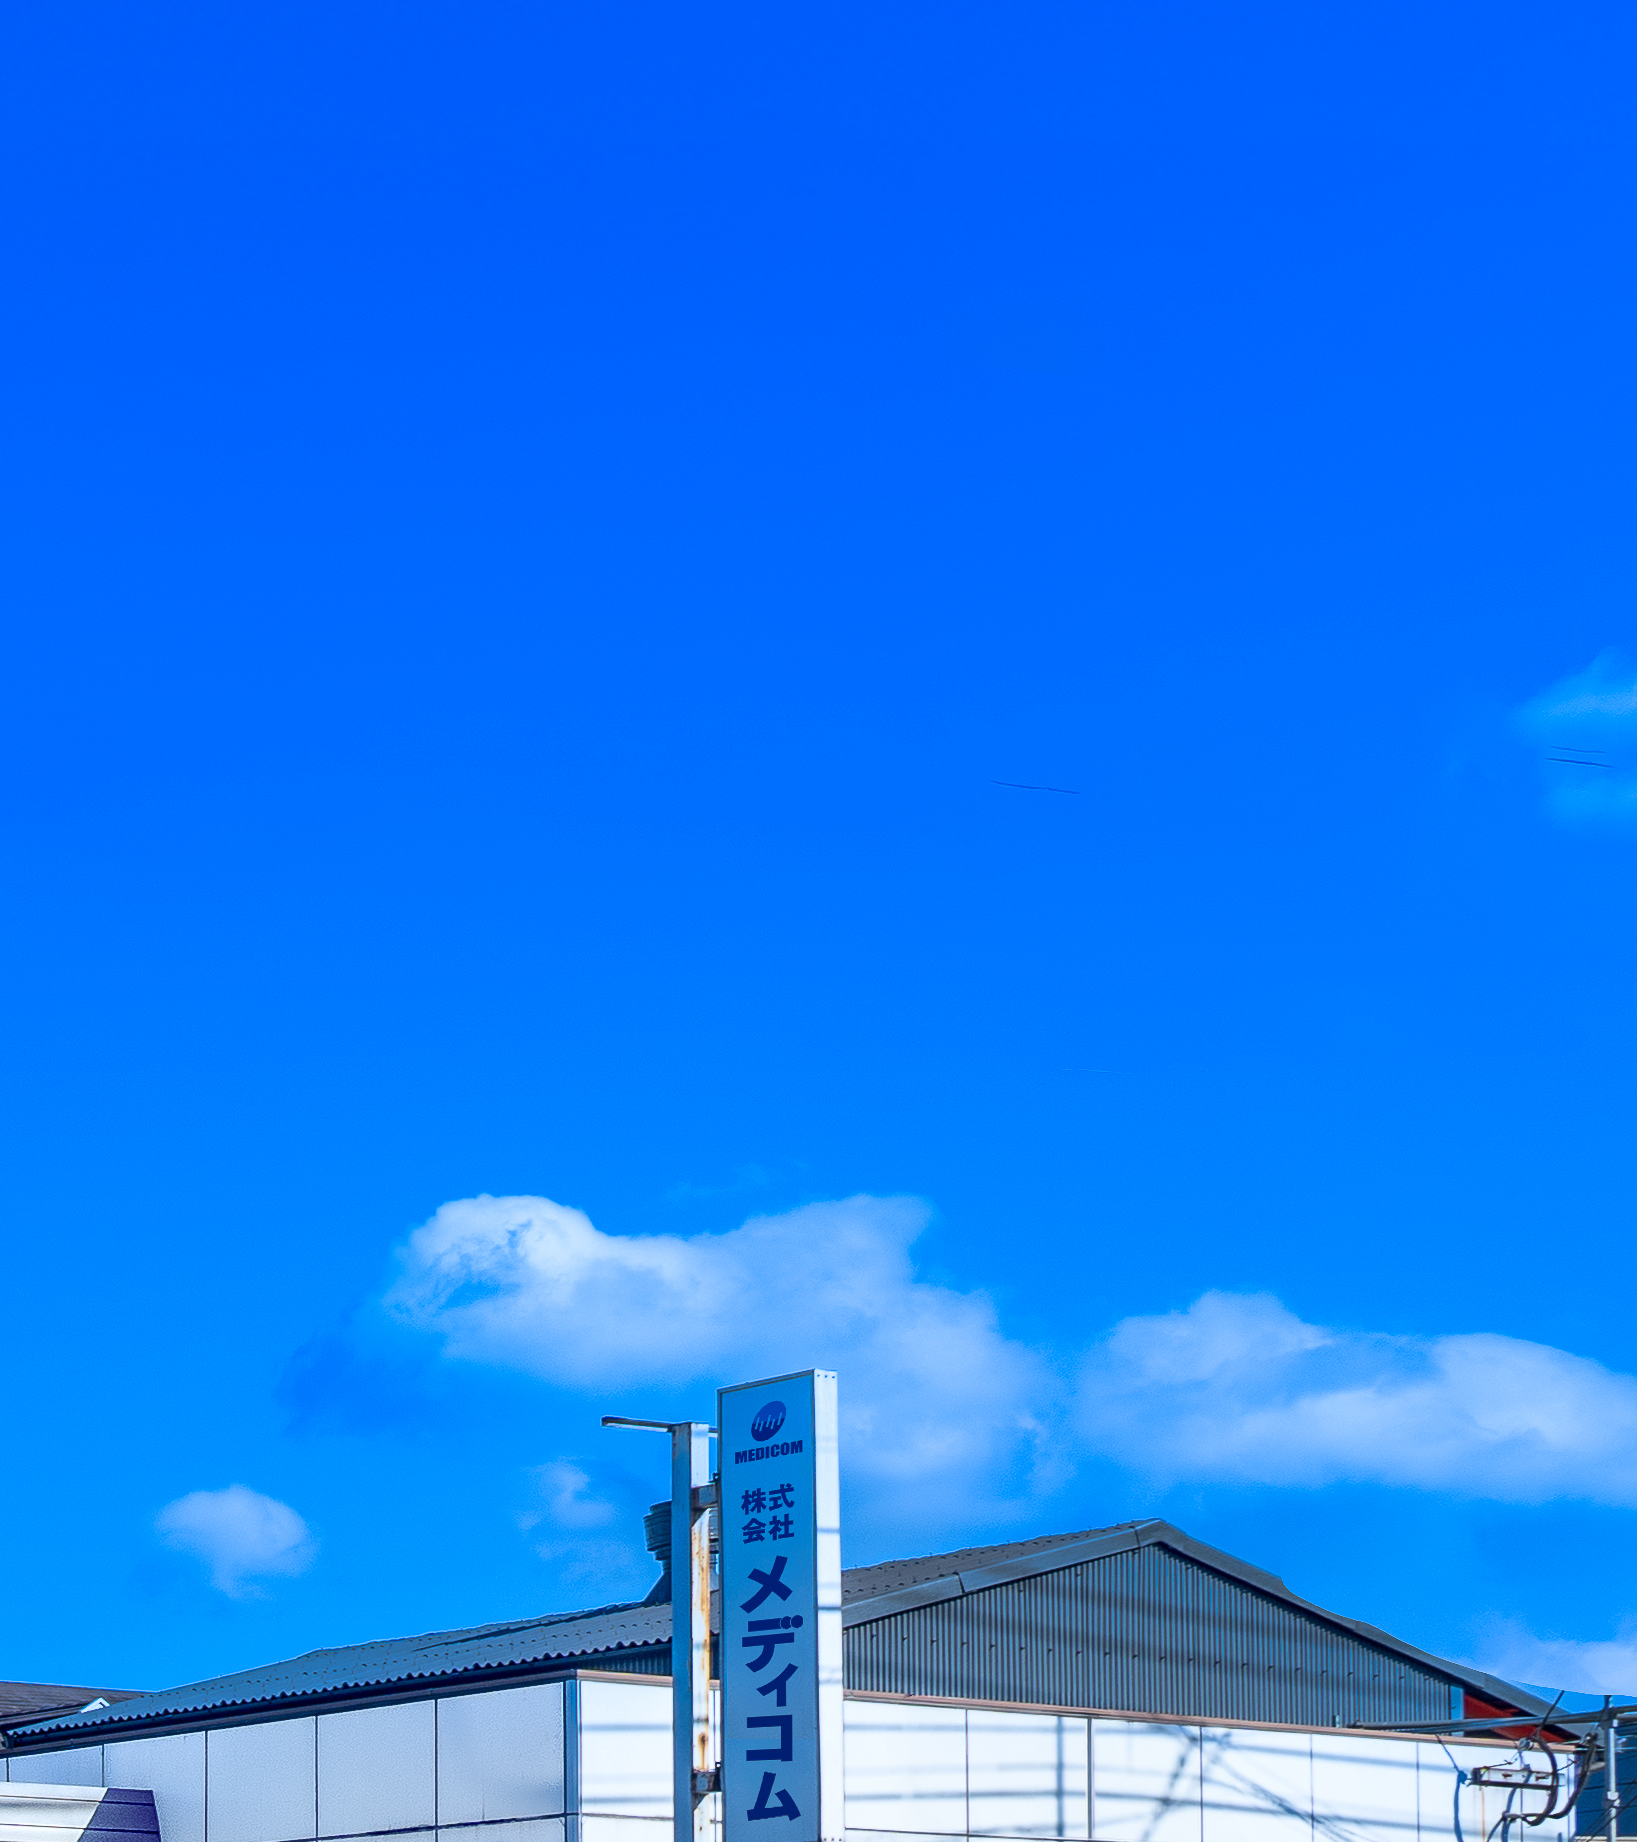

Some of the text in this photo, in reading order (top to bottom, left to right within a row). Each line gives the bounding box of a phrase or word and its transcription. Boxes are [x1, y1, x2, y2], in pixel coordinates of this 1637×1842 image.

[734, 1440, 803, 1465] MEDICOM
[741, 1483, 795, 1515] 株式
[741, 1513, 795, 1545] 会社
[739, 1555, 804, 1822] メディコム
